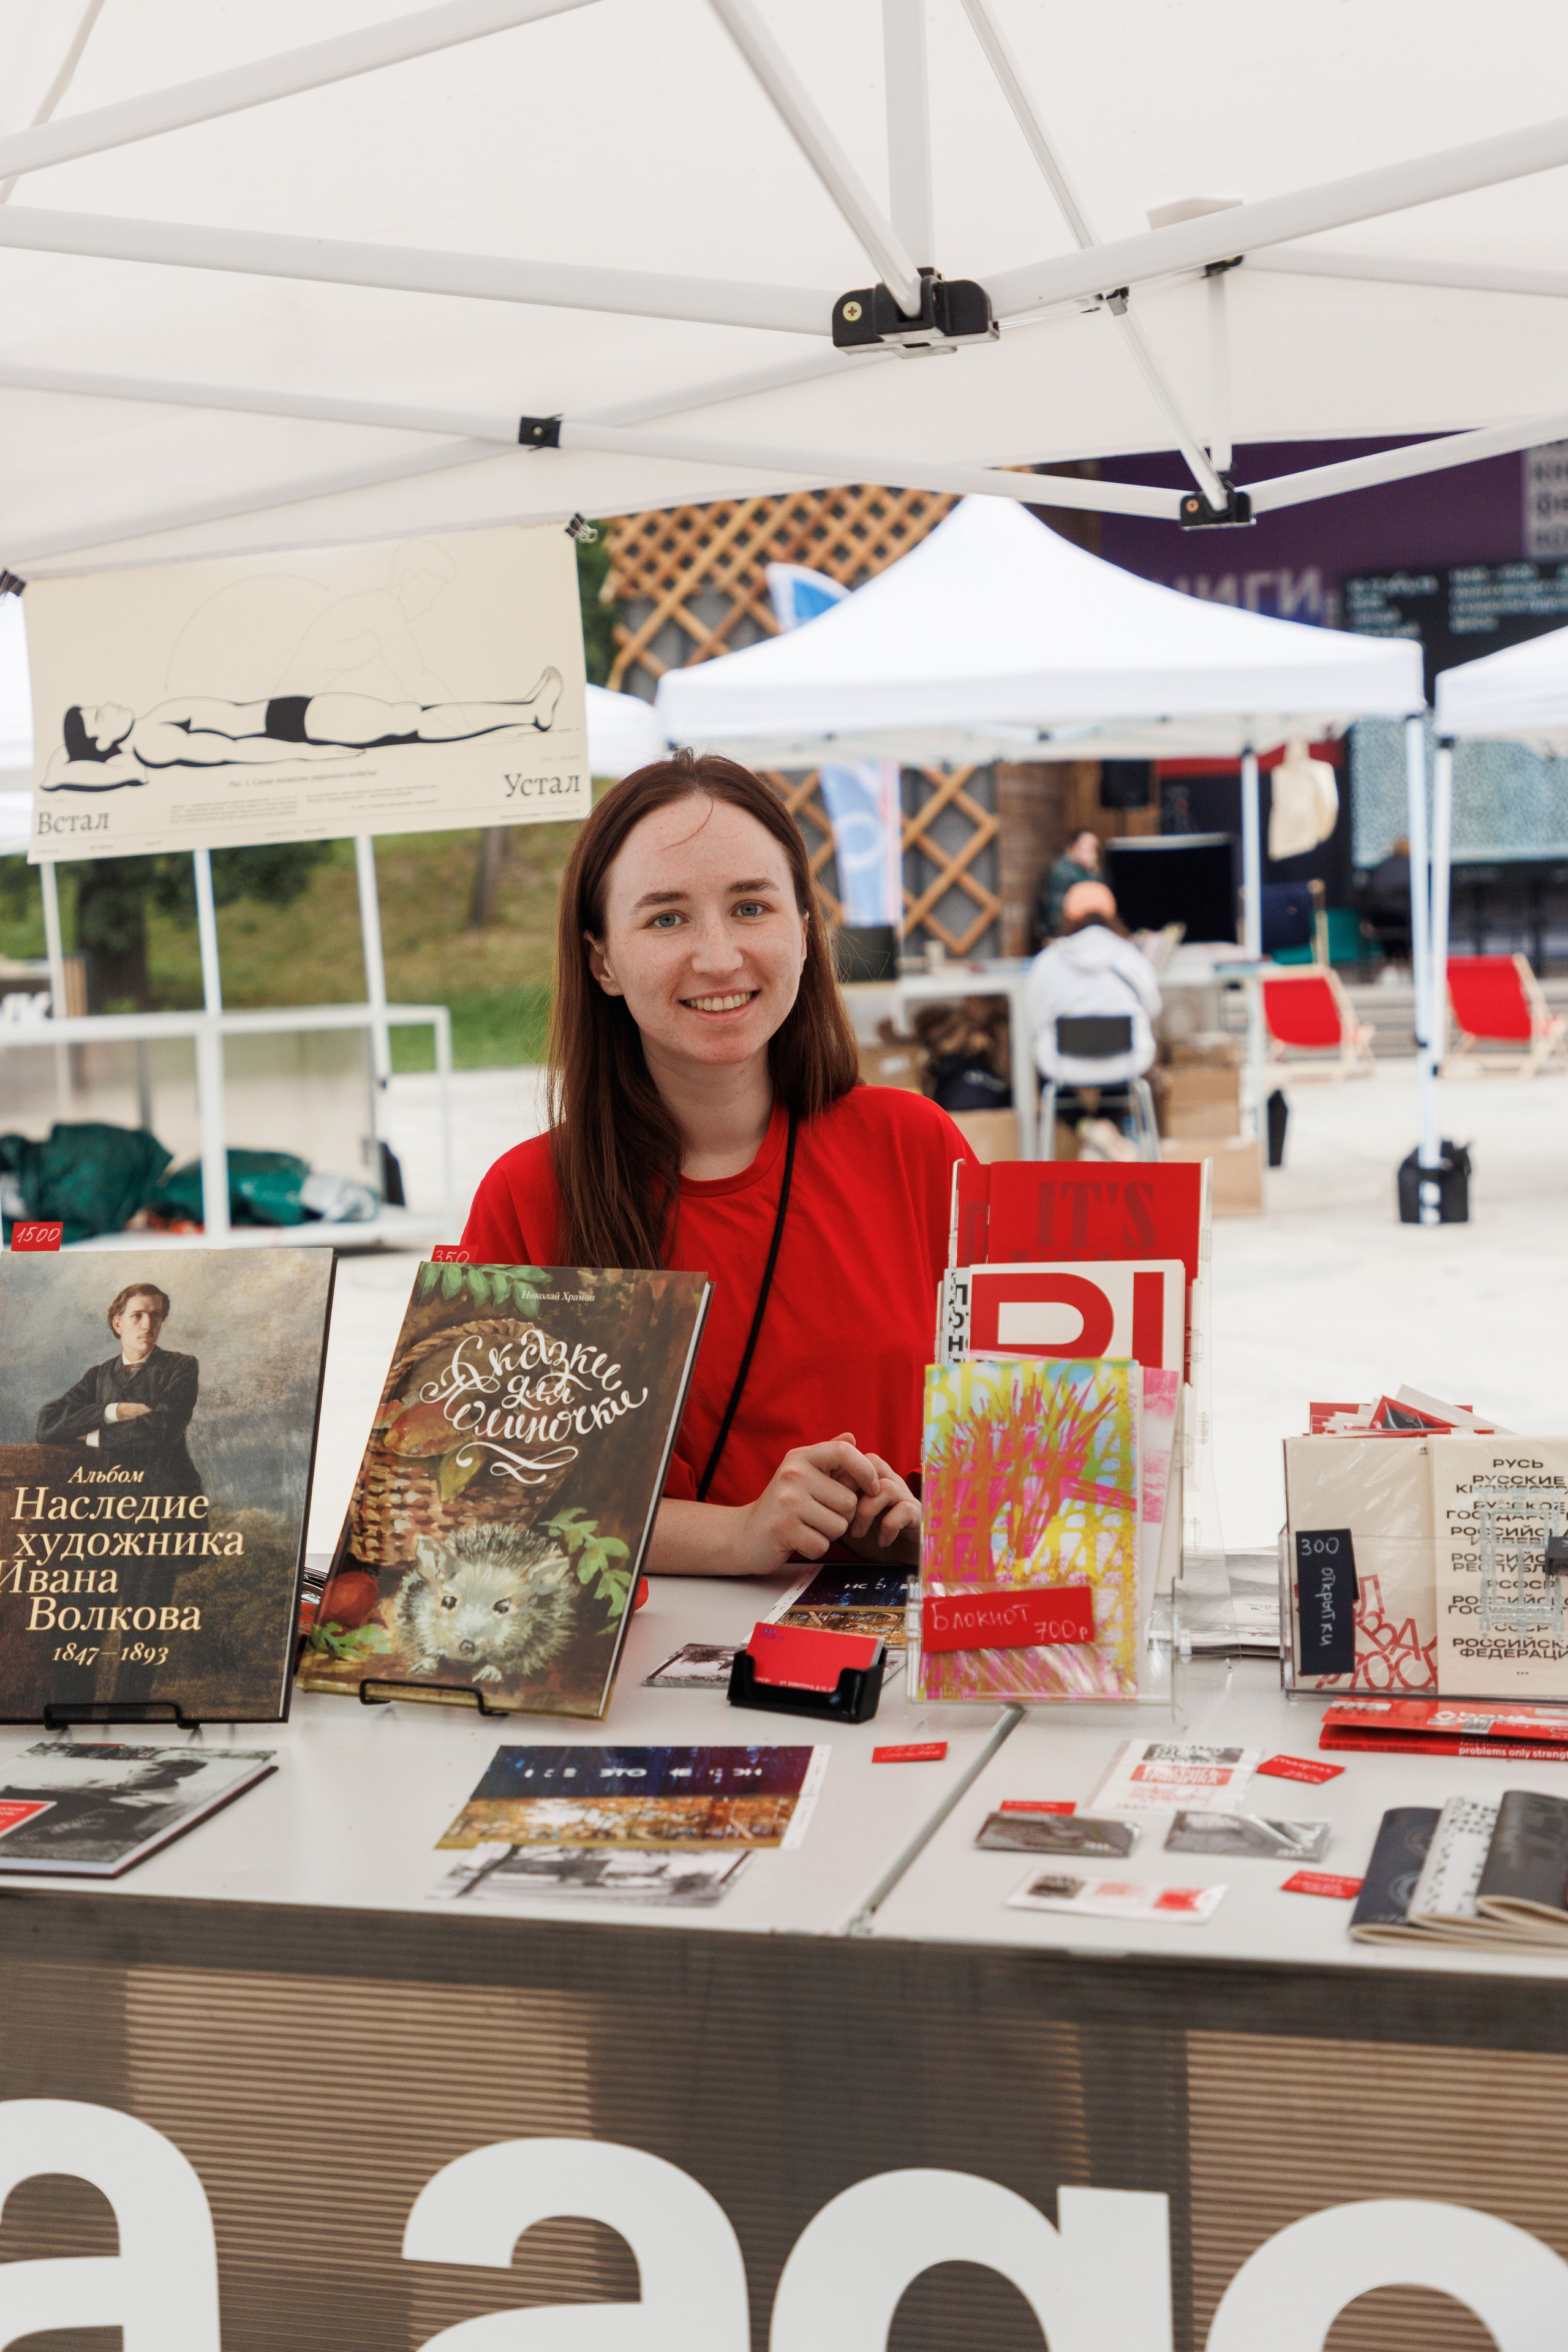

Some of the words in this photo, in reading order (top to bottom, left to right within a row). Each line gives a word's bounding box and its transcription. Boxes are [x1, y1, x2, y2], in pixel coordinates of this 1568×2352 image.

[504, 773, 580, 797] Устал
[37, 812, 110, 834] Встал
[1036, 1180, 1156, 1251] IT'S
[16, 1226, 61, 1243] 1500
[435, 1250, 470, 1263] 350
[522, 1291, 560, 1300] Николай
[562, 1291, 595, 1303] Храмов
[420, 1330, 622, 1403] Сказки
[501, 1375, 575, 1411] для
[67, 1464, 145, 1483] Альбом
[1493, 1458, 1544, 1469] РУСЬ
[1472, 1475, 1565, 1485] РУССКИЕ
[10, 1487, 209, 1525] Наследие
[13, 1531, 244, 1566] художника
[1301, 1537, 1340, 1556] 300
[0, 1559, 118, 1593] Ивана
[25, 1596, 202, 1631] Волкова
[931, 1600, 1030, 1631] Блокнот
[1453, 1637, 1568, 1649] РОССИЙСК
[1459, 1747, 1506, 1757] problems
[1509, 1749, 1530, 1759] only
